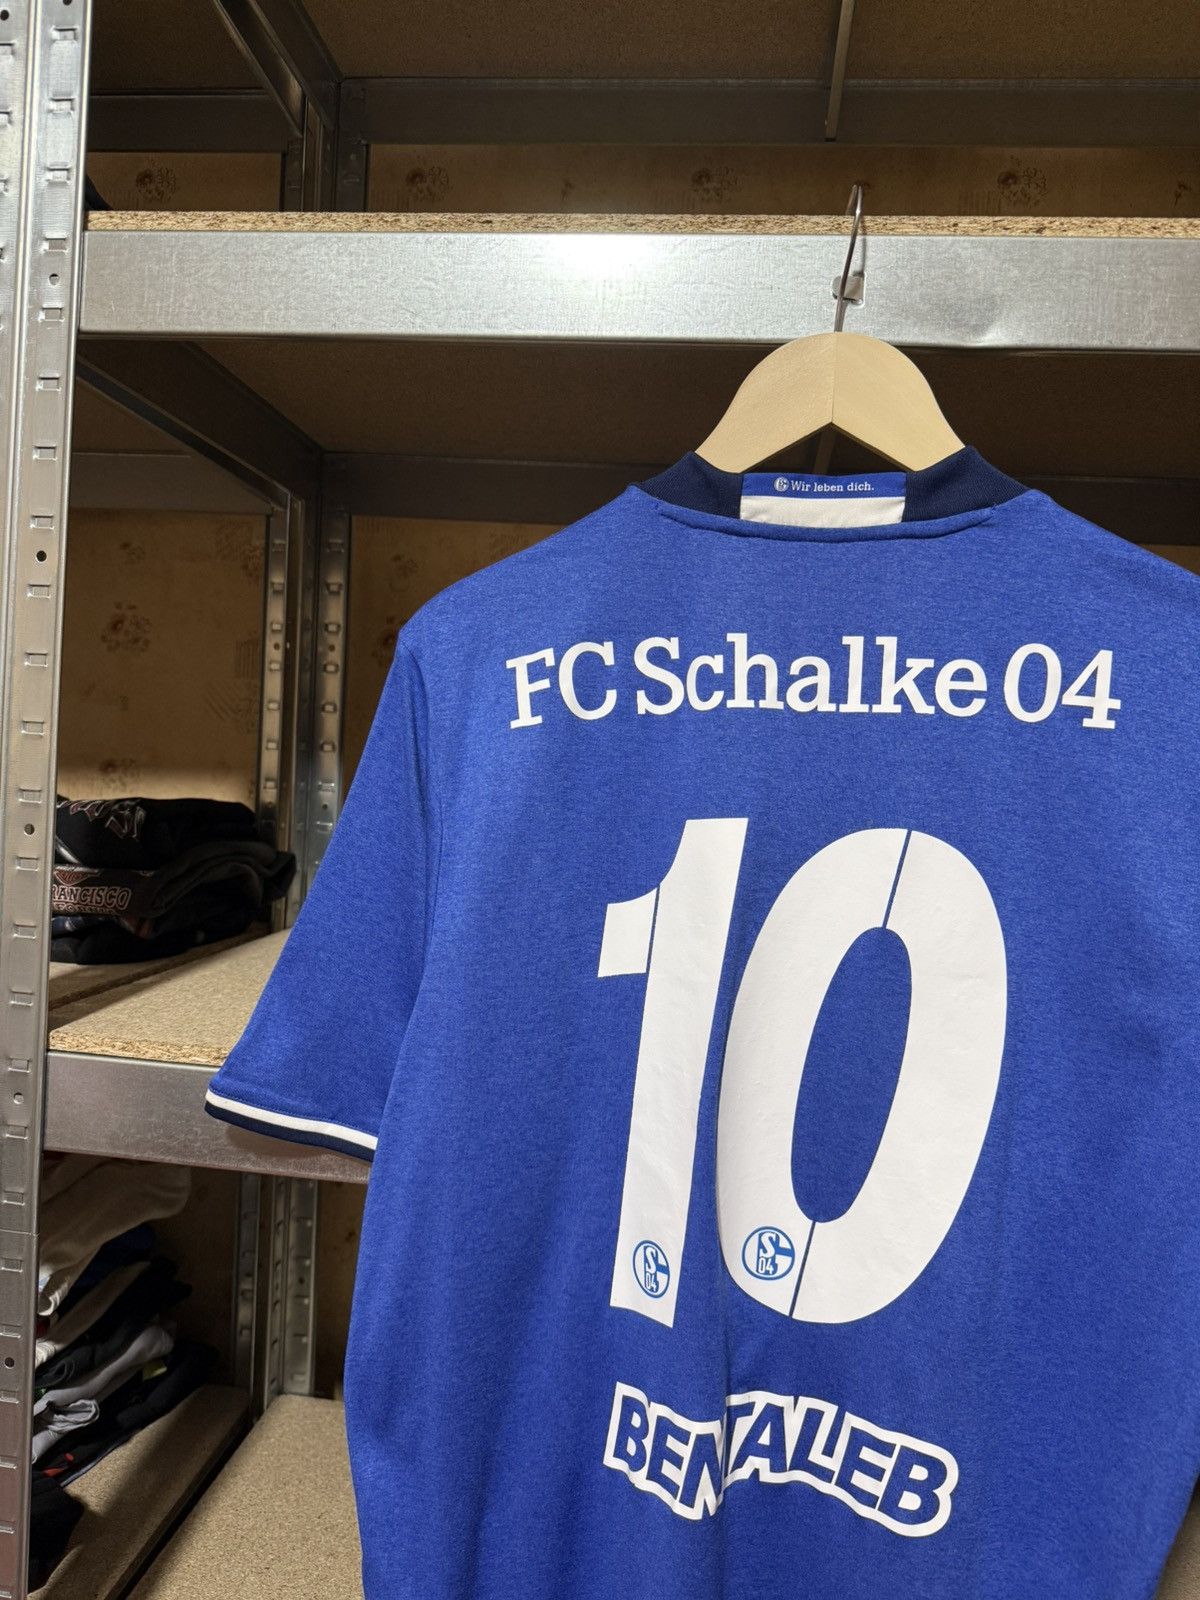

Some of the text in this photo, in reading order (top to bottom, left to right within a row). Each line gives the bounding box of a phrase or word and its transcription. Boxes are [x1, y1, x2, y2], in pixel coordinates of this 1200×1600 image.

[791, 480, 811, 491] Wir
[813, 482, 843, 492] leben
[847, 481, 875, 491] dich.
[506, 633, 1121, 730] FC Schalke 04
[598, 817, 1008, 1327] 10
[604, 1381, 959, 1537] BENTALEB
